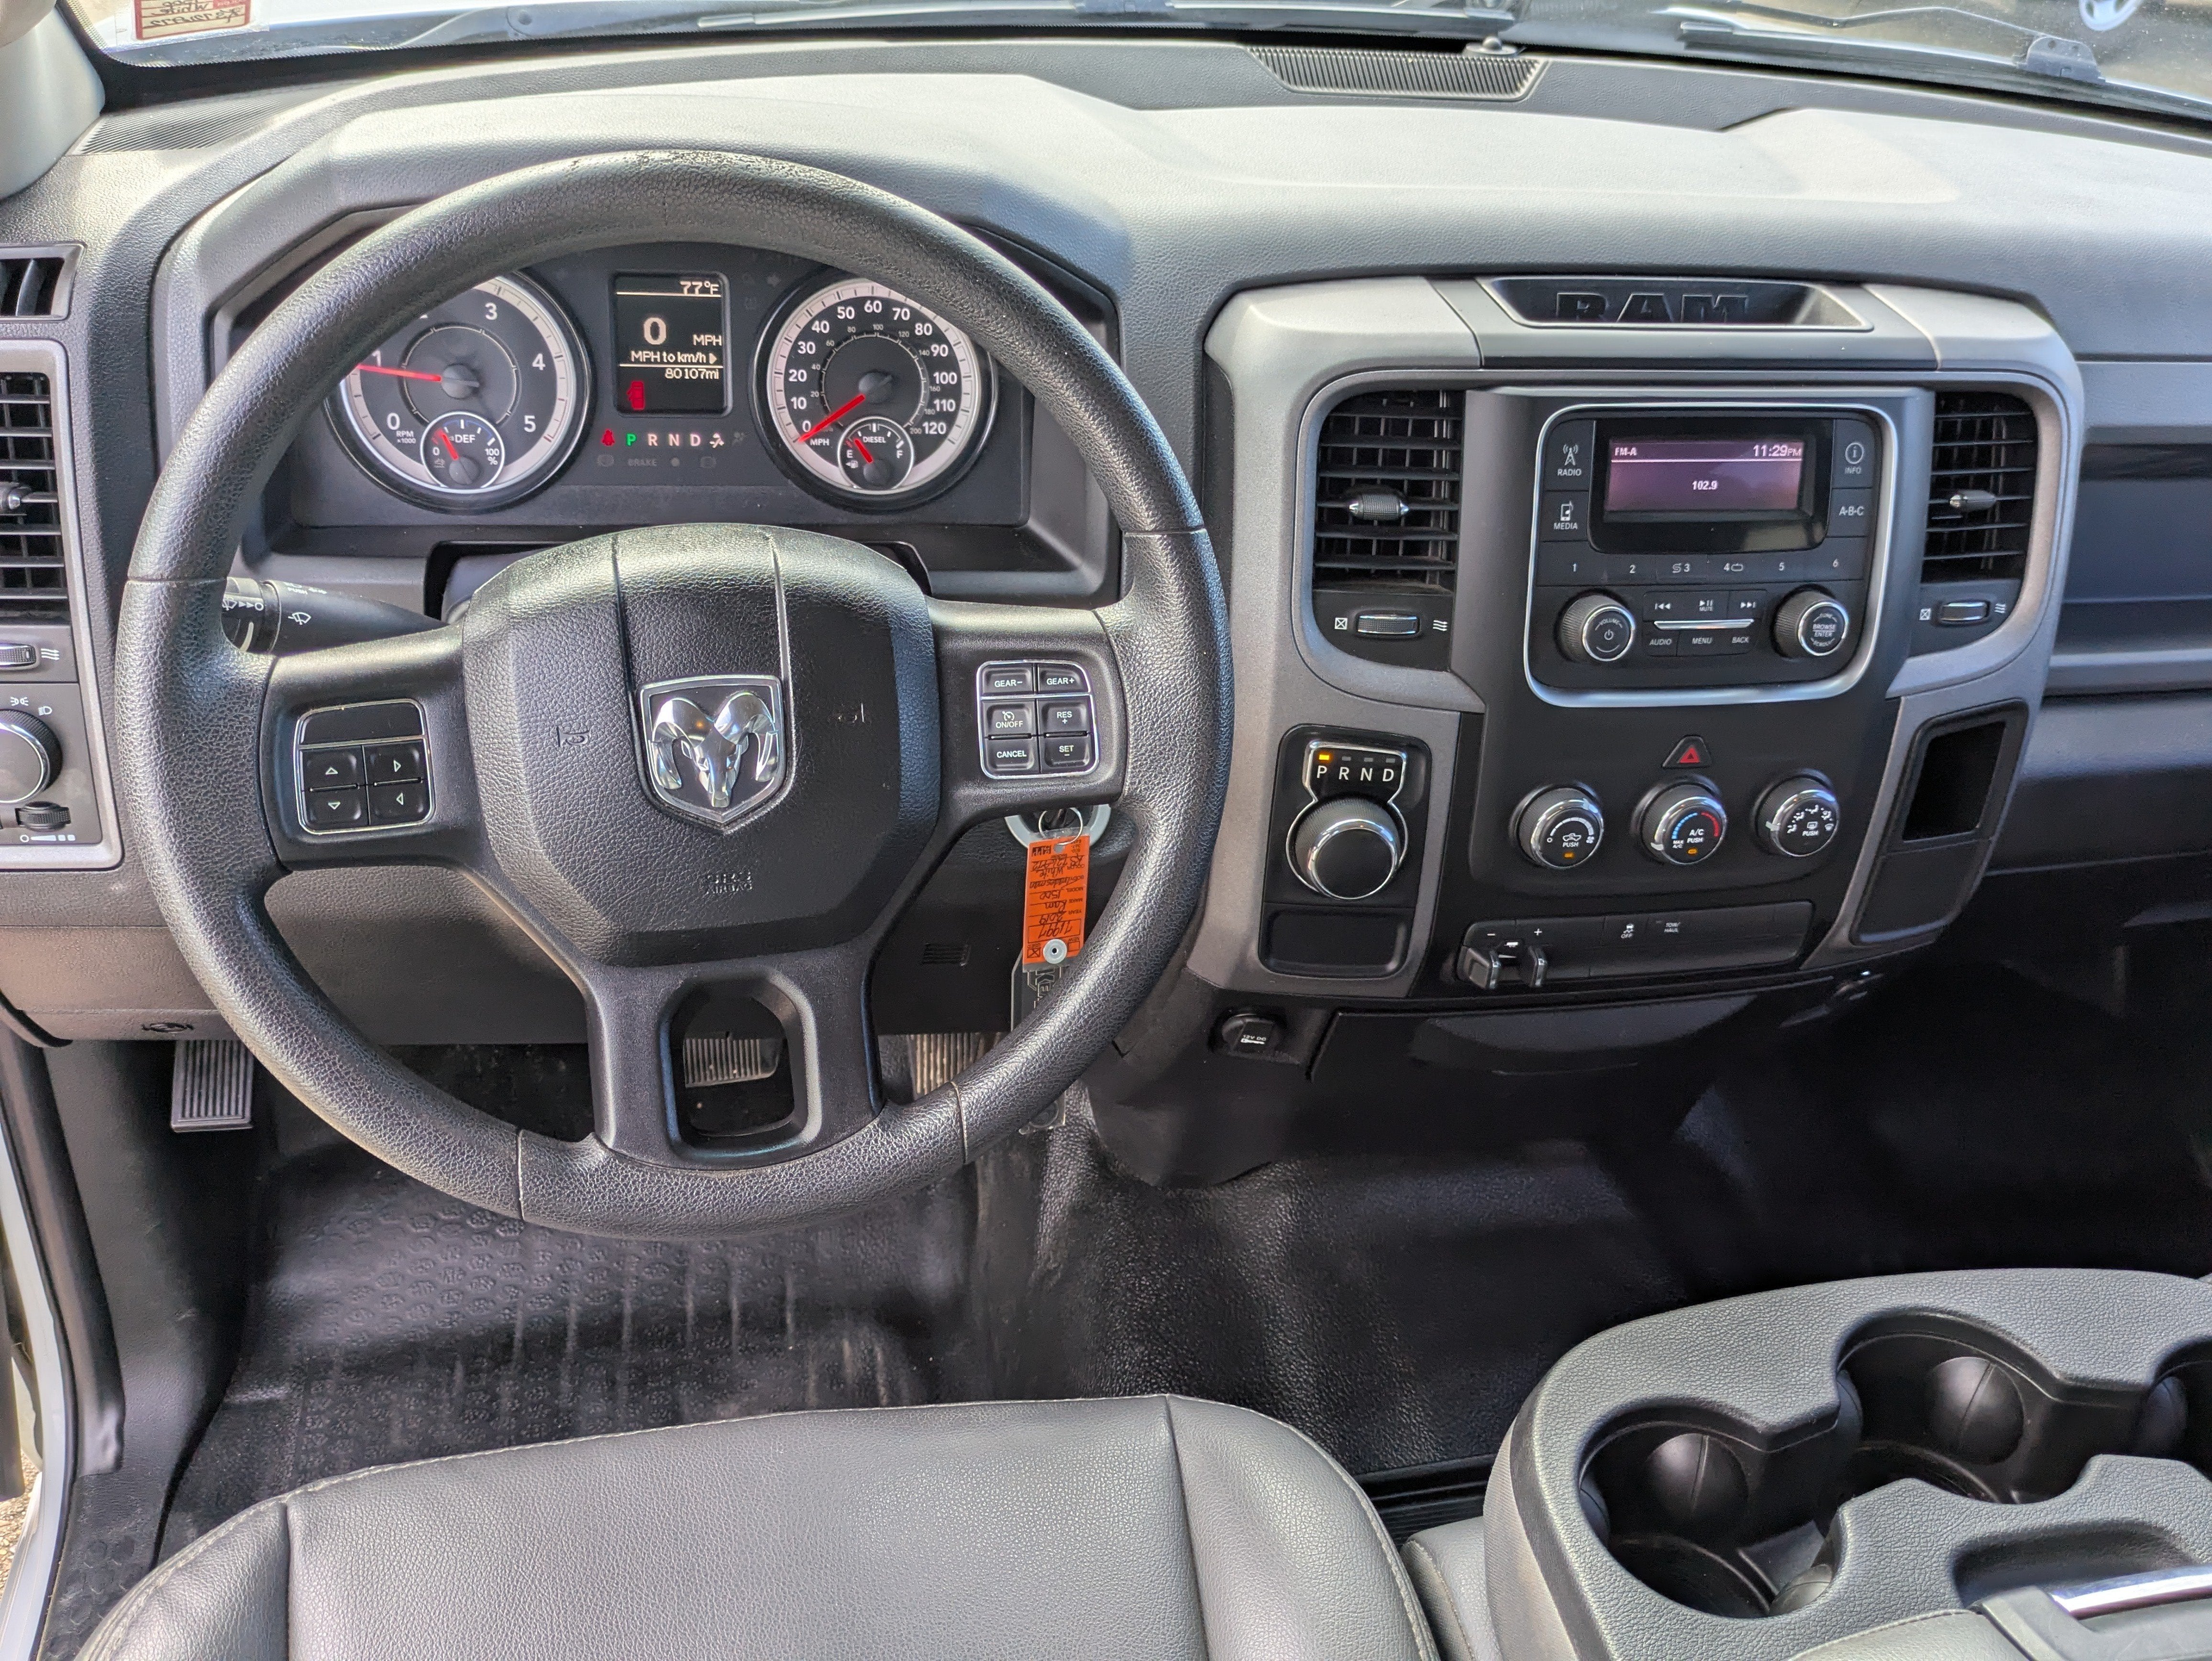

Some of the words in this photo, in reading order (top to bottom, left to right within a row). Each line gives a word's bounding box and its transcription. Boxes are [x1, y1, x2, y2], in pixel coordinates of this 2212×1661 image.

[680, 281, 719, 295] 77°F
[485, 303, 498, 320] 3
[864, 300, 882, 313] 60
[1556, 292, 1749, 324] RAM
[837, 307, 855, 320] 50
[892, 308, 910, 321] 70
[643, 318, 666, 345] 0
[812, 321, 830, 333] 40
[915, 323, 933, 336] 80
[693, 335, 722, 346] MPH
[797, 342, 816, 354] 30
[931, 344, 949, 357] 90
[372, 350, 381, 365] 1
[531, 354, 545, 370] 4
[630, 351, 660, 363] MPH
[663, 352, 675, 363] to
[677, 352, 706, 364] km/h
[788, 369, 807, 382] 20
[933, 372, 957, 385] 100
[791, 397, 807, 410] 10
[934, 399, 956, 412] 110
[387, 413, 400, 430] 0
[524, 415, 536, 432] 5
[802, 420, 812, 433] 0
[923, 422, 947, 434] 120
[455, 435, 476, 443] DEF
[626, 433, 637, 446] P
[648, 433, 658, 446] R
[669, 433, 680, 446] N
[690, 433, 702, 446] D
[809, 438, 830, 446] MPH
[432, 447, 440, 456] 0
[485, 448, 500, 457] 100
[847, 450, 853, 459] E
[896, 450, 903, 459] F
[1615, 447, 1637, 457] FM-A
[1557, 468, 1582, 477] RADIO
[1692, 480, 1718, 491] 102.9
[1553, 522, 1578, 531] MEDIA
[1572, 564, 1577, 573] 1
[1629, 565, 1636, 574] 2
[1683, 563, 1690, 573] 3
[1724, 563, 1730, 572] 4
[1779, 562, 1785, 571] 5
[1833, 559, 1838, 568] 6
[996, 750, 1027, 758] CANCEL
[1316, 765, 1327, 778] P
[1338, 767, 1349, 780] R
[1360, 768, 1372, 782] N
[1382, 768, 1394, 782] D
[1689, 828, 1704, 836] A/C
